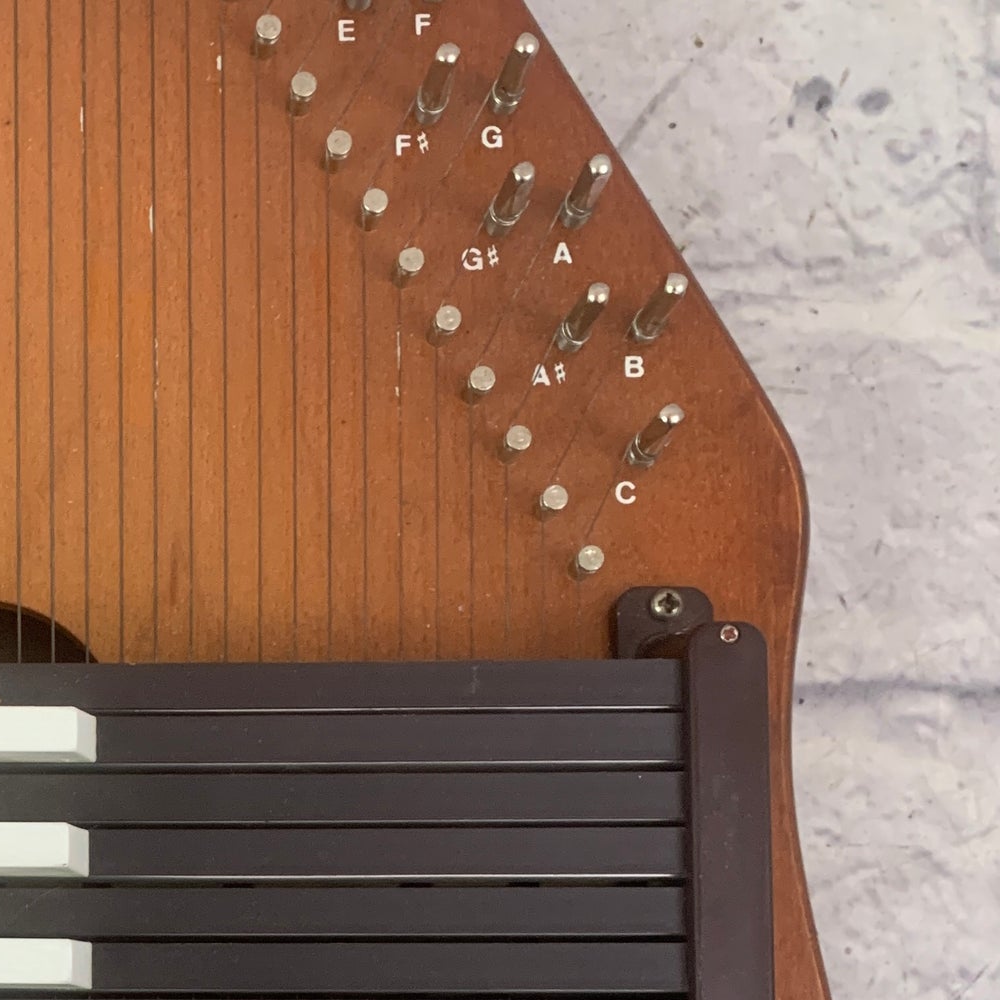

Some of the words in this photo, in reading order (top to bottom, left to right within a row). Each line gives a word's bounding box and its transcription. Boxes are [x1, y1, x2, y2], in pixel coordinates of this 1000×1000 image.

[338, 20, 356, 42] E
[414, 14, 430, 35] F
[481, 127, 503, 149] G
[553, 243, 573, 265] A
[625, 356, 645, 378] B
[615, 482, 637, 505] C
